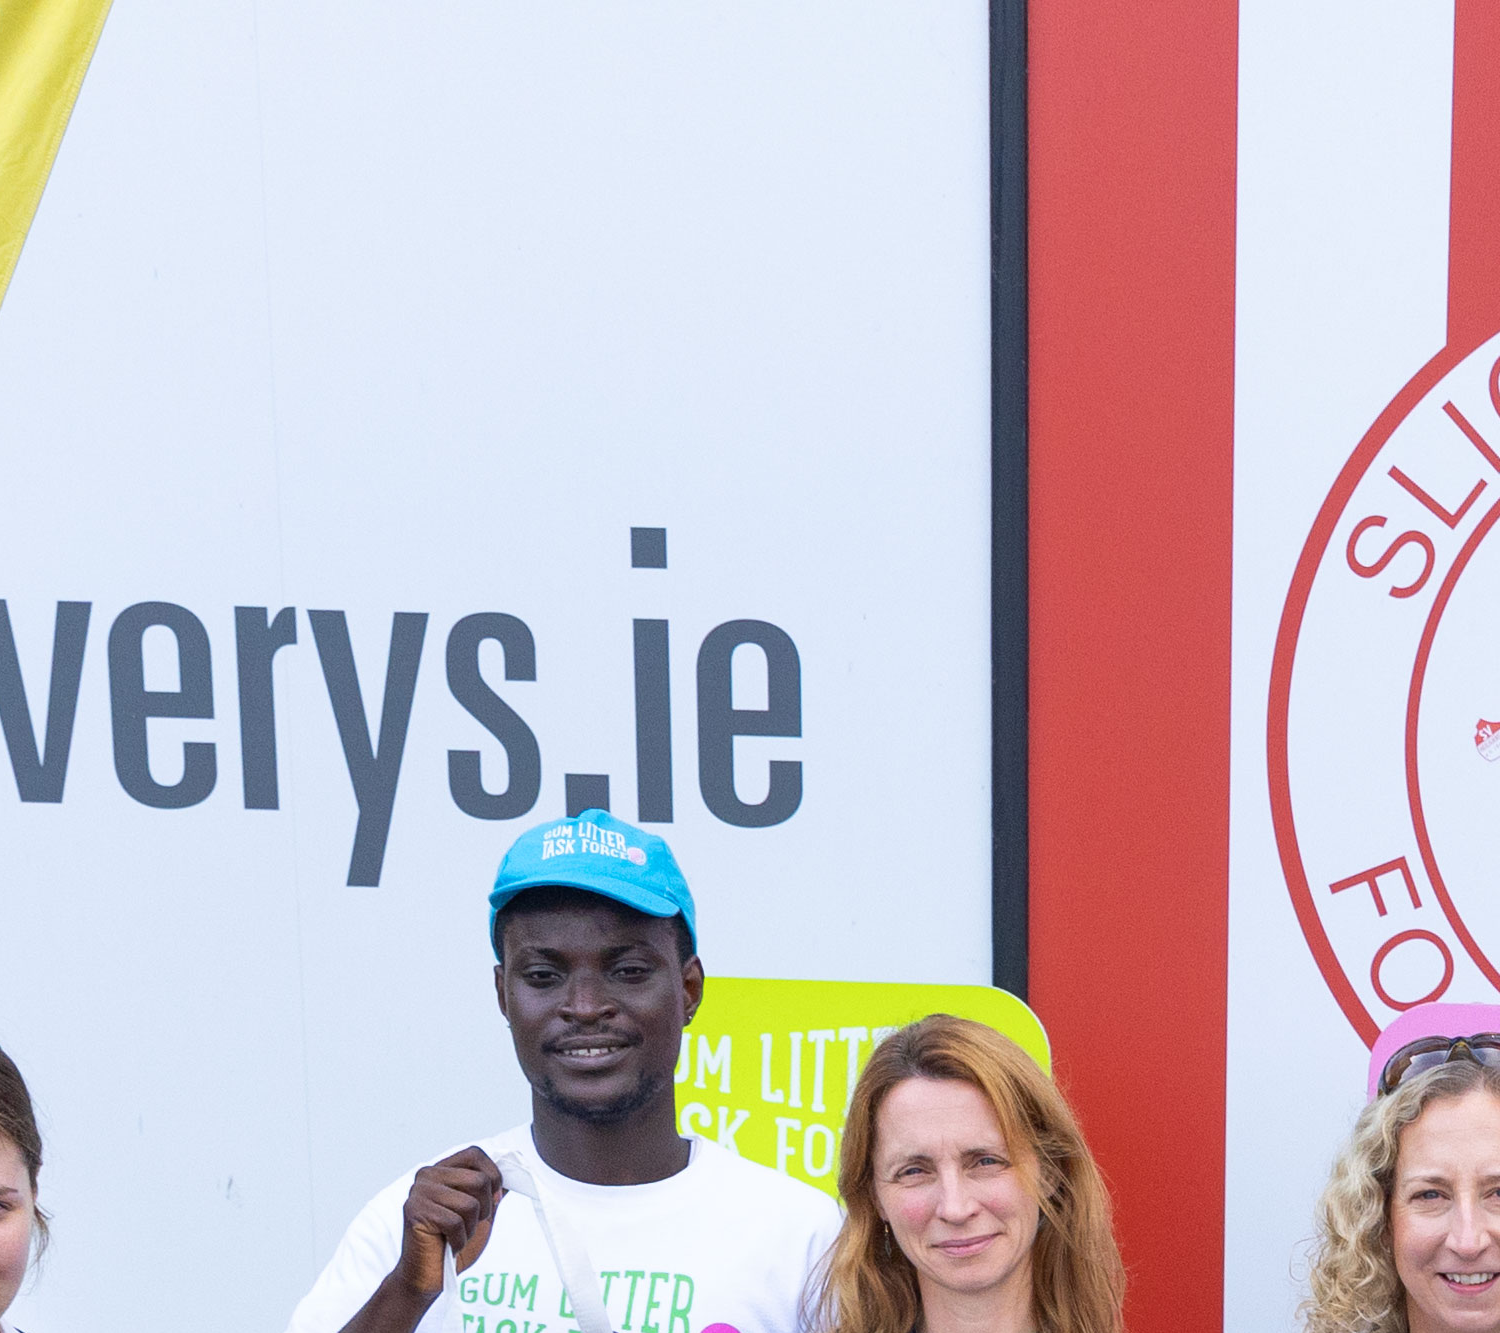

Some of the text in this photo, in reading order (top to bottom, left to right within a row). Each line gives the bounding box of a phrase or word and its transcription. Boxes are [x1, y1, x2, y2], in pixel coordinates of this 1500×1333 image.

[544, 822, 626, 849] GUM LITTER
[542, 839, 575, 860] TASK
[460, 1273, 539, 1312] GUM
